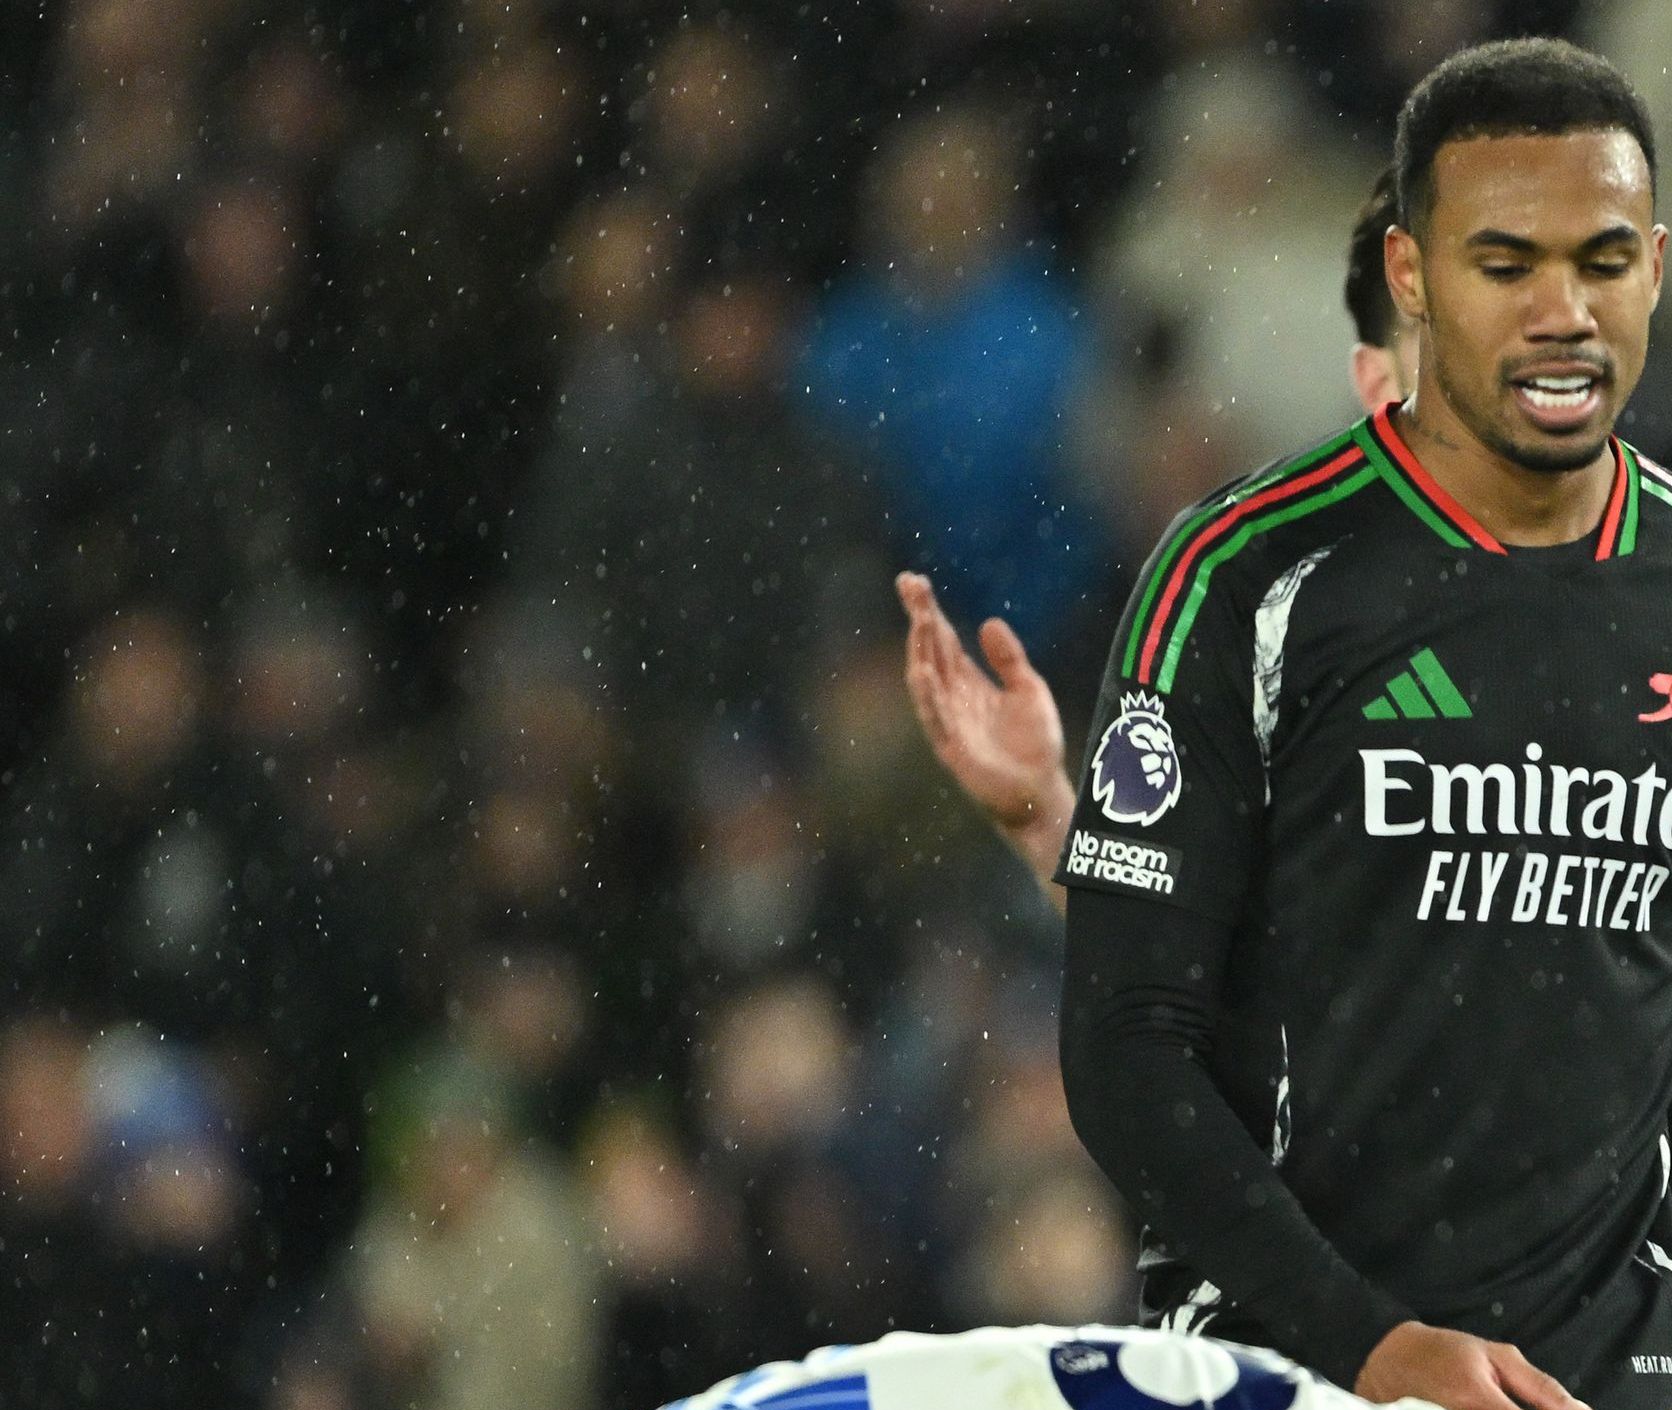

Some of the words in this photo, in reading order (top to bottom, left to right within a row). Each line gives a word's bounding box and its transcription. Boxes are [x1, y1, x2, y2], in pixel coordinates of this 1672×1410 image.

[1072, 829, 1099, 856] No
[1100, 839, 1168, 872] room
[1093, 858, 1174, 895] racism
[1416, 850, 1509, 922] FLY
[1511, 852, 1670, 932] BETTER
